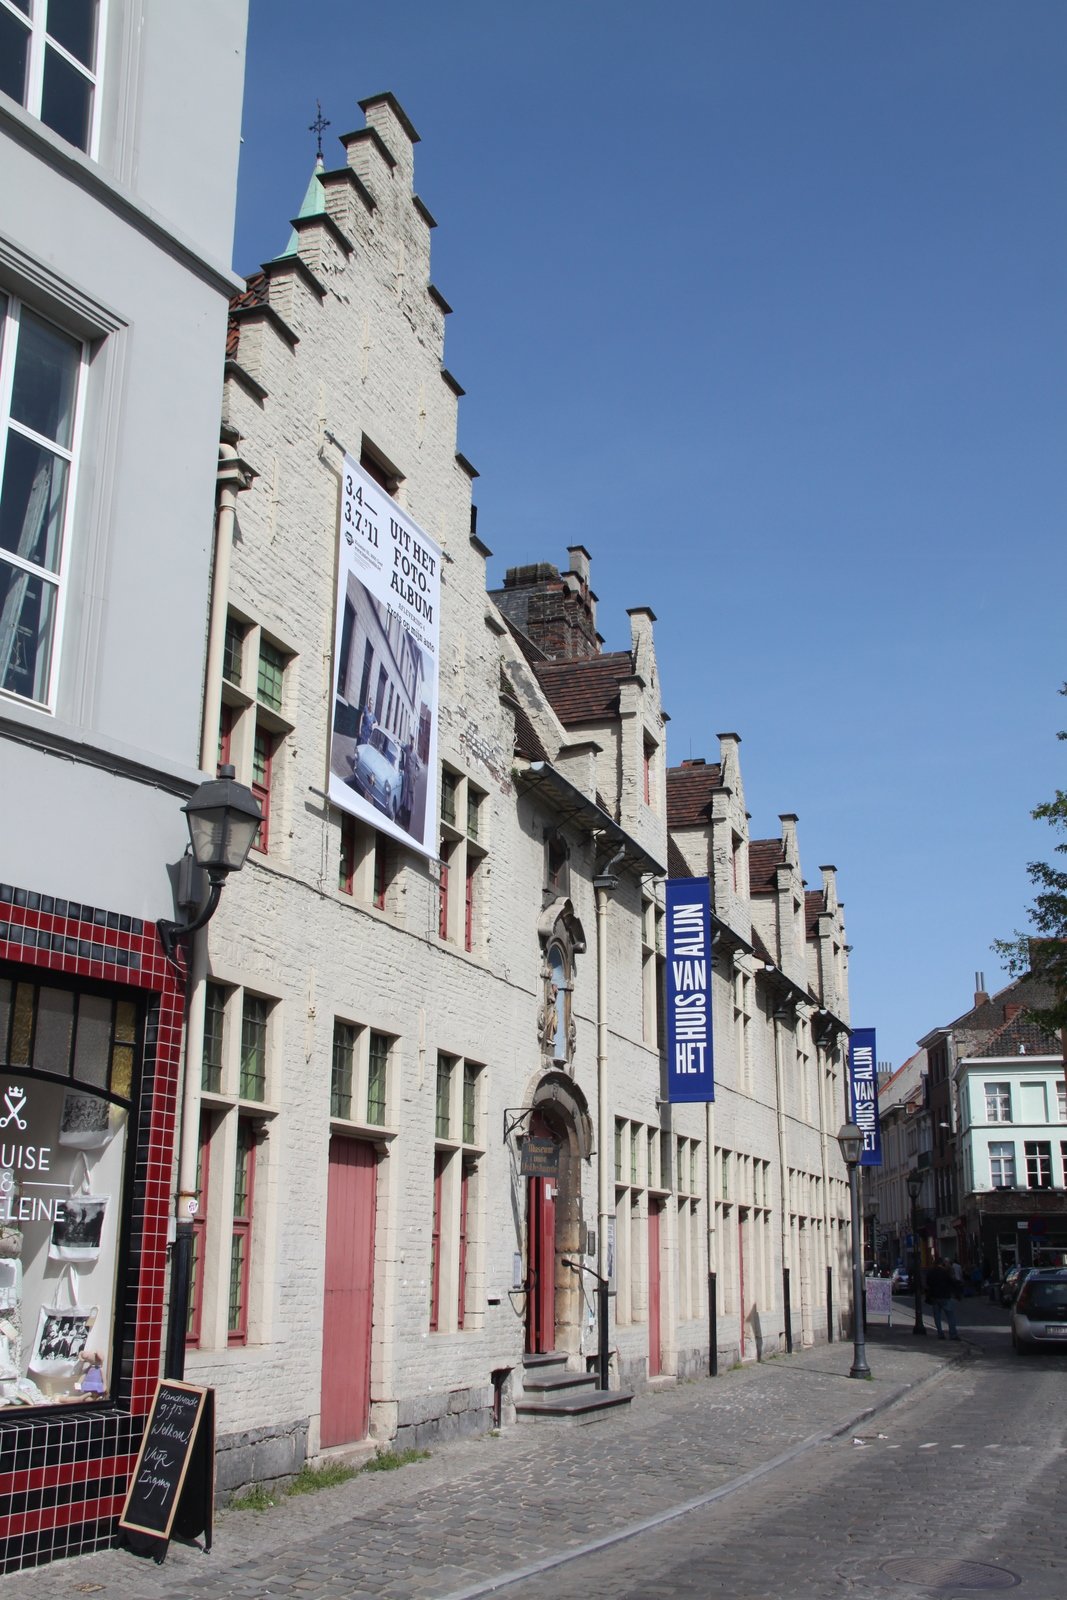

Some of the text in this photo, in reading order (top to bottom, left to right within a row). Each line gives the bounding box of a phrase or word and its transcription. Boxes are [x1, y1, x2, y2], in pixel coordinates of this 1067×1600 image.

[389, 517, 411, 553] UIT
[412, 540, 436, 577] HET
[393, 546, 431, 594] FOTO-
[390, 570, 433, 625] ALBUM
[386, 602, 402, 624] Trots
[402, 619, 411, 632] op
[672, 903, 707, 1074] HET HUIS VAN ALIJN
[853, 1046, 873, 1080] ALIJN
[854, 1081, 874, 1101] VAN
[856, 1101, 875, 1130] HUIS
[1, 1143, 51, 1171] UISE
[0, 1172, 15, 1192] &
